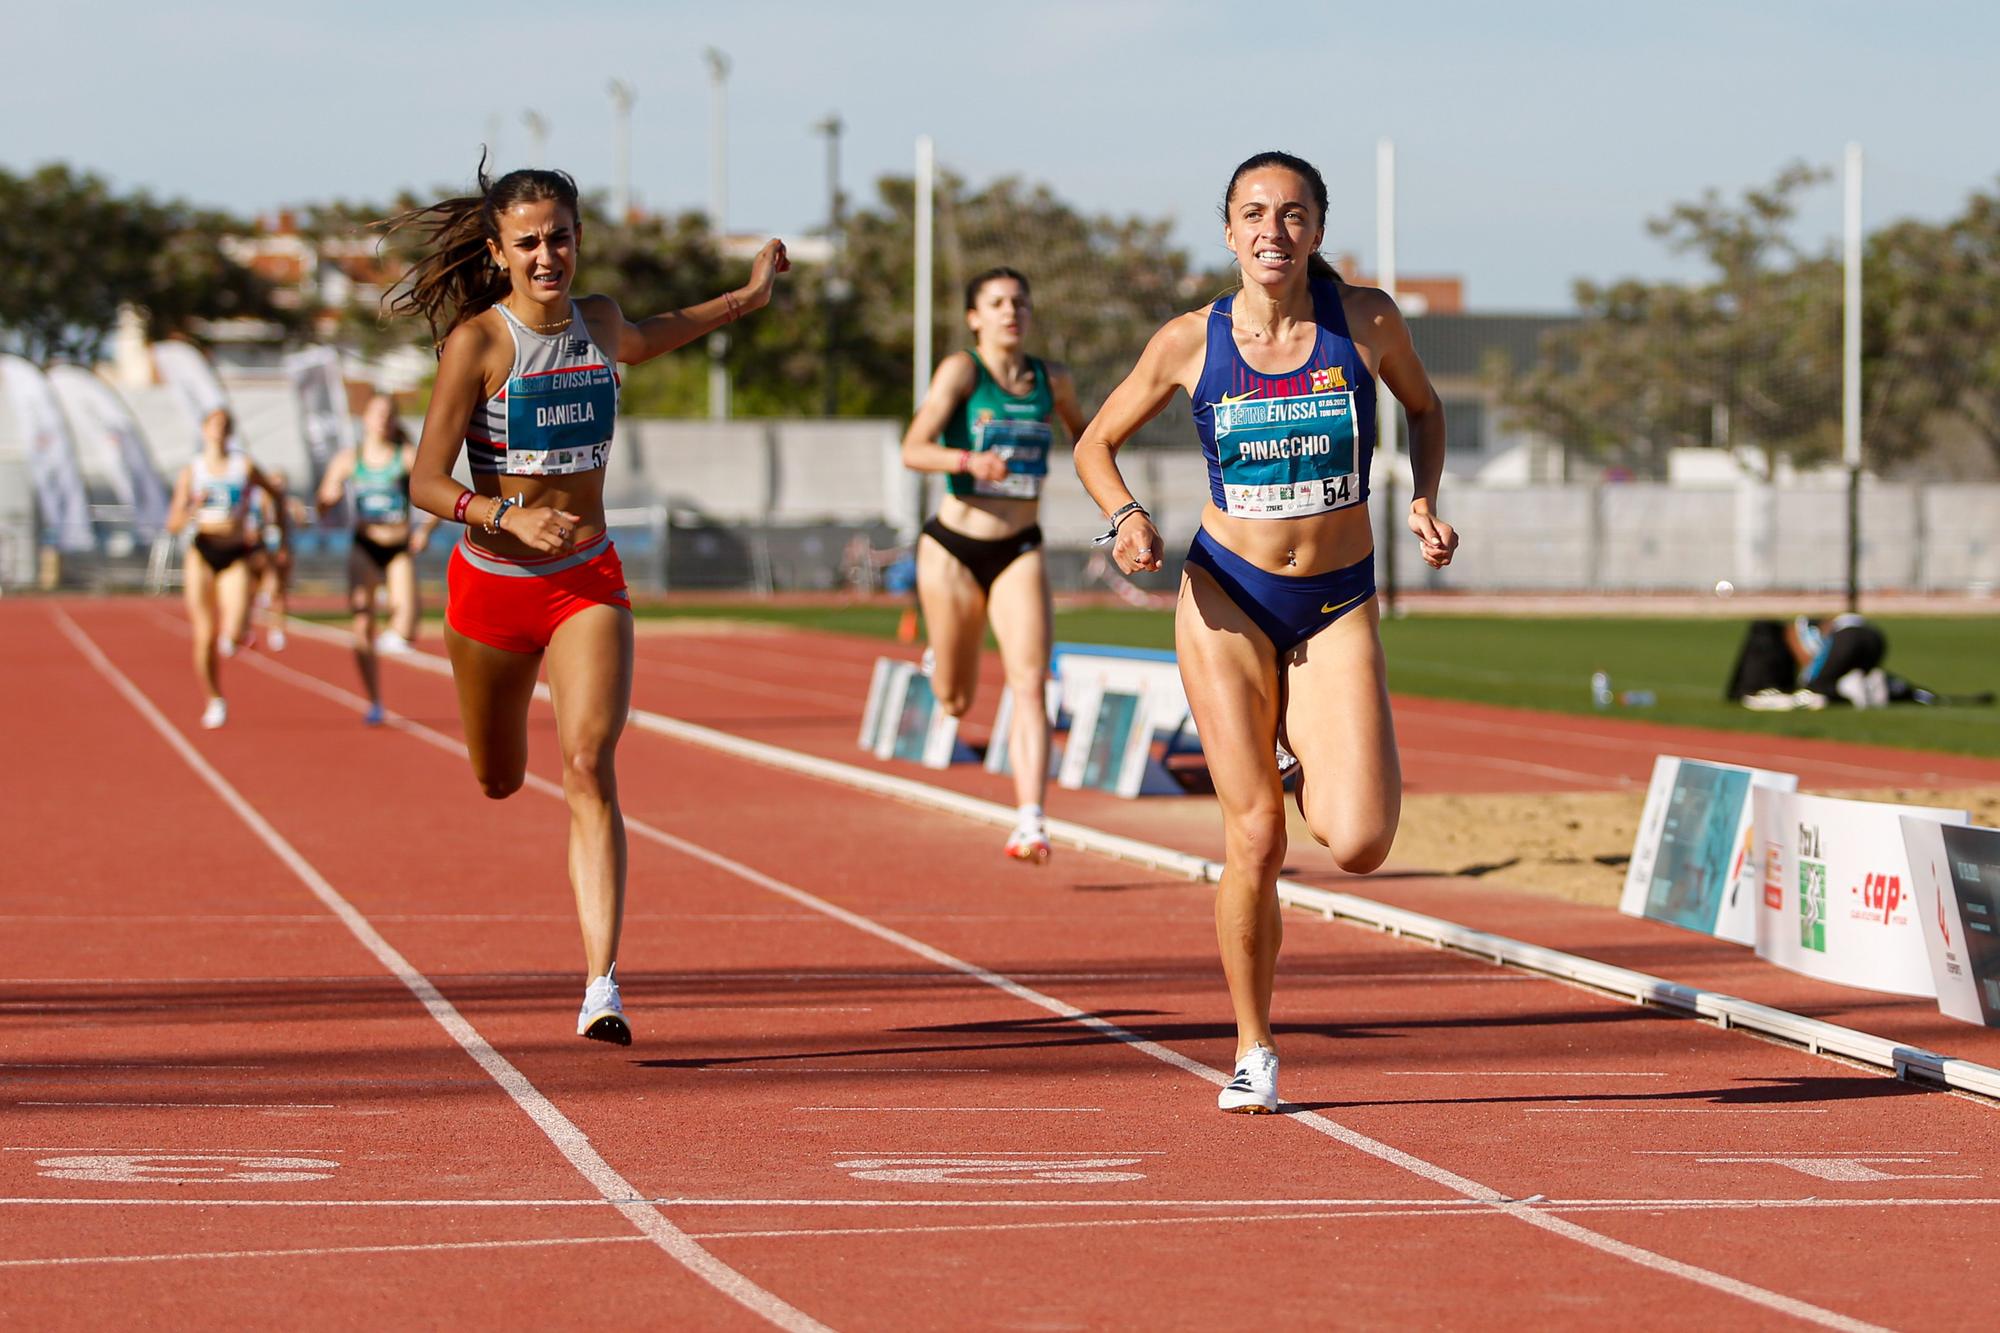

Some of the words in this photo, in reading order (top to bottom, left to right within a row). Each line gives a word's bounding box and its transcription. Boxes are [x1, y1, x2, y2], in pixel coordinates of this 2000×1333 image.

[552, 371, 592, 390] EIVISSA
[537, 402, 594, 427] DANIELA
[1267, 402, 1318, 423] EIVISSA
[1239, 434, 1330, 461] PINACCHIO
[1322, 475, 1351, 506] 54
[1864, 872, 1900, 925] cap
